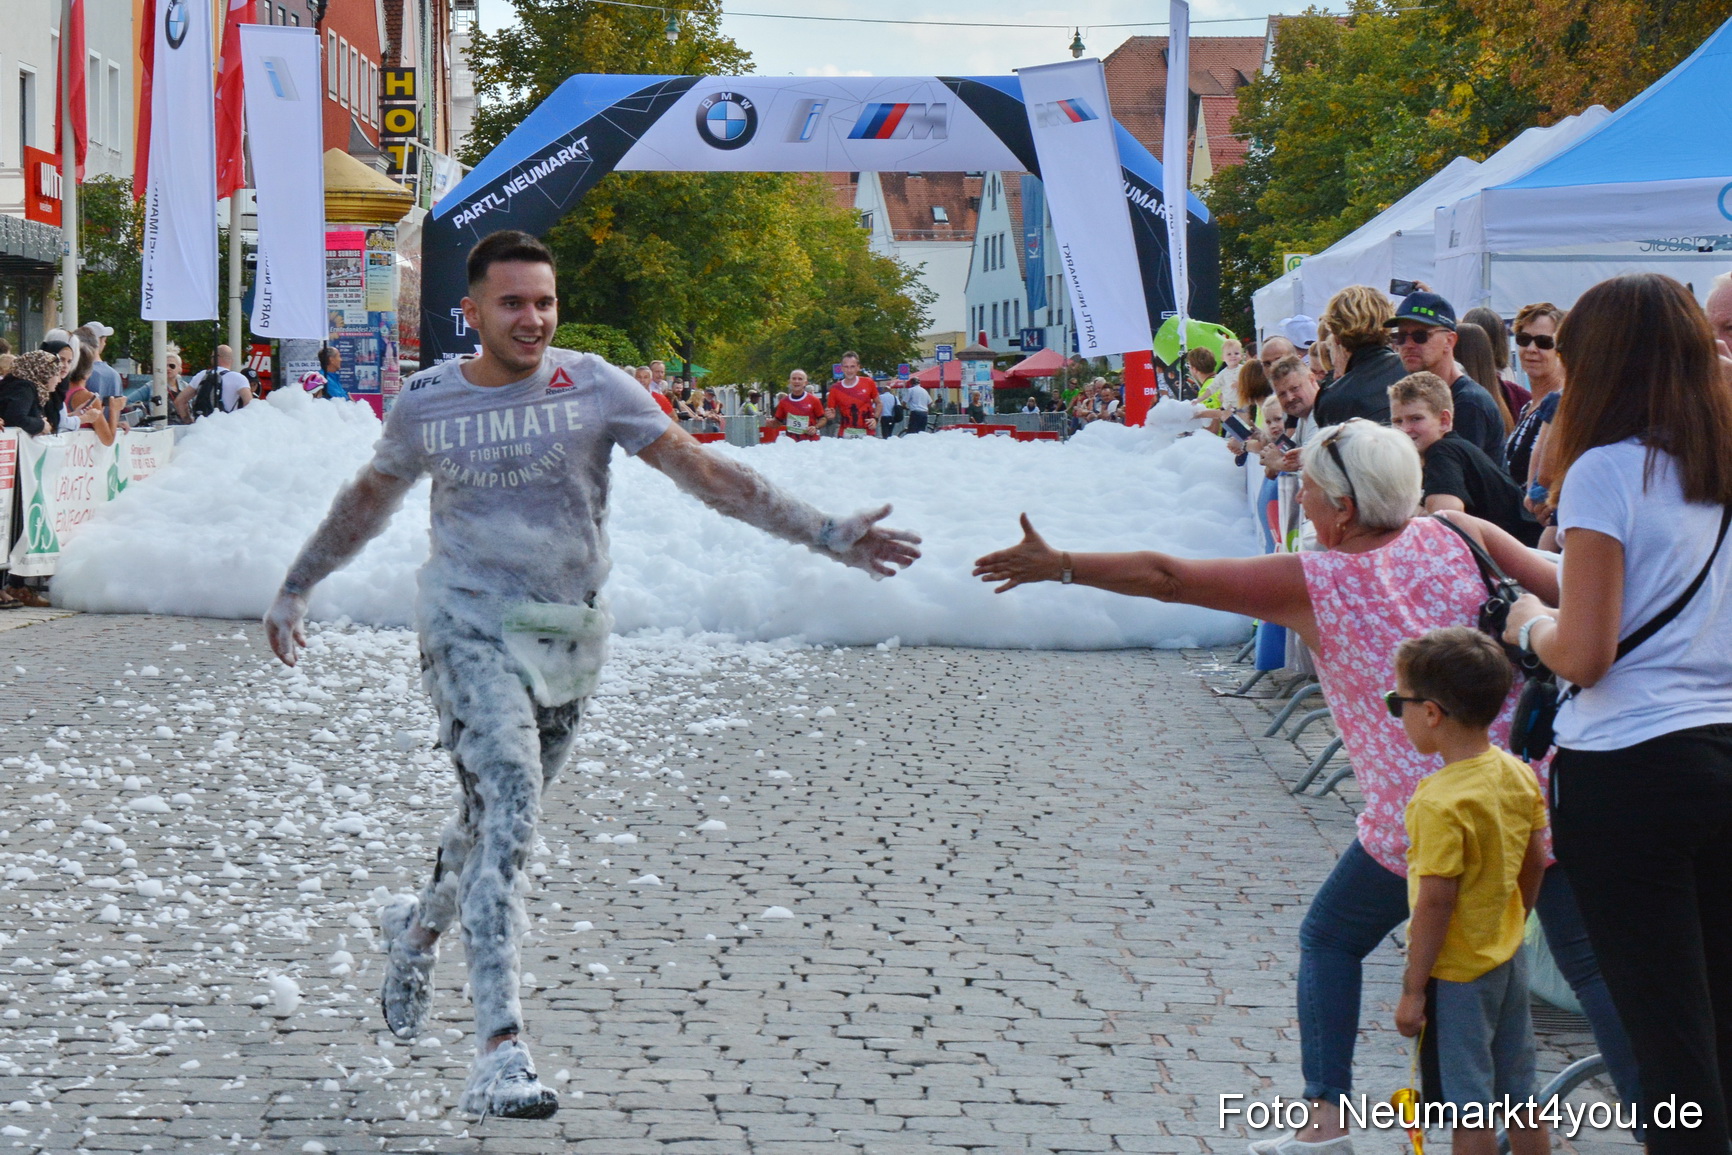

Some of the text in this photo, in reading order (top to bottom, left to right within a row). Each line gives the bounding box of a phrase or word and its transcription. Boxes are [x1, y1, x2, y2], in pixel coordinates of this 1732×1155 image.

[701, 92, 752, 110] BMW
[385, 71, 416, 190] HOT
[452, 136, 590, 229] PARTL NEUMARKT
[409, 374, 442, 391] UFC
[545, 386, 578, 395] Reebok
[422, 400, 583, 454] ULTIMATE
[440, 441, 566, 489] CHAMPIONSHIP
[470, 442, 533, 463] FIGHTING
